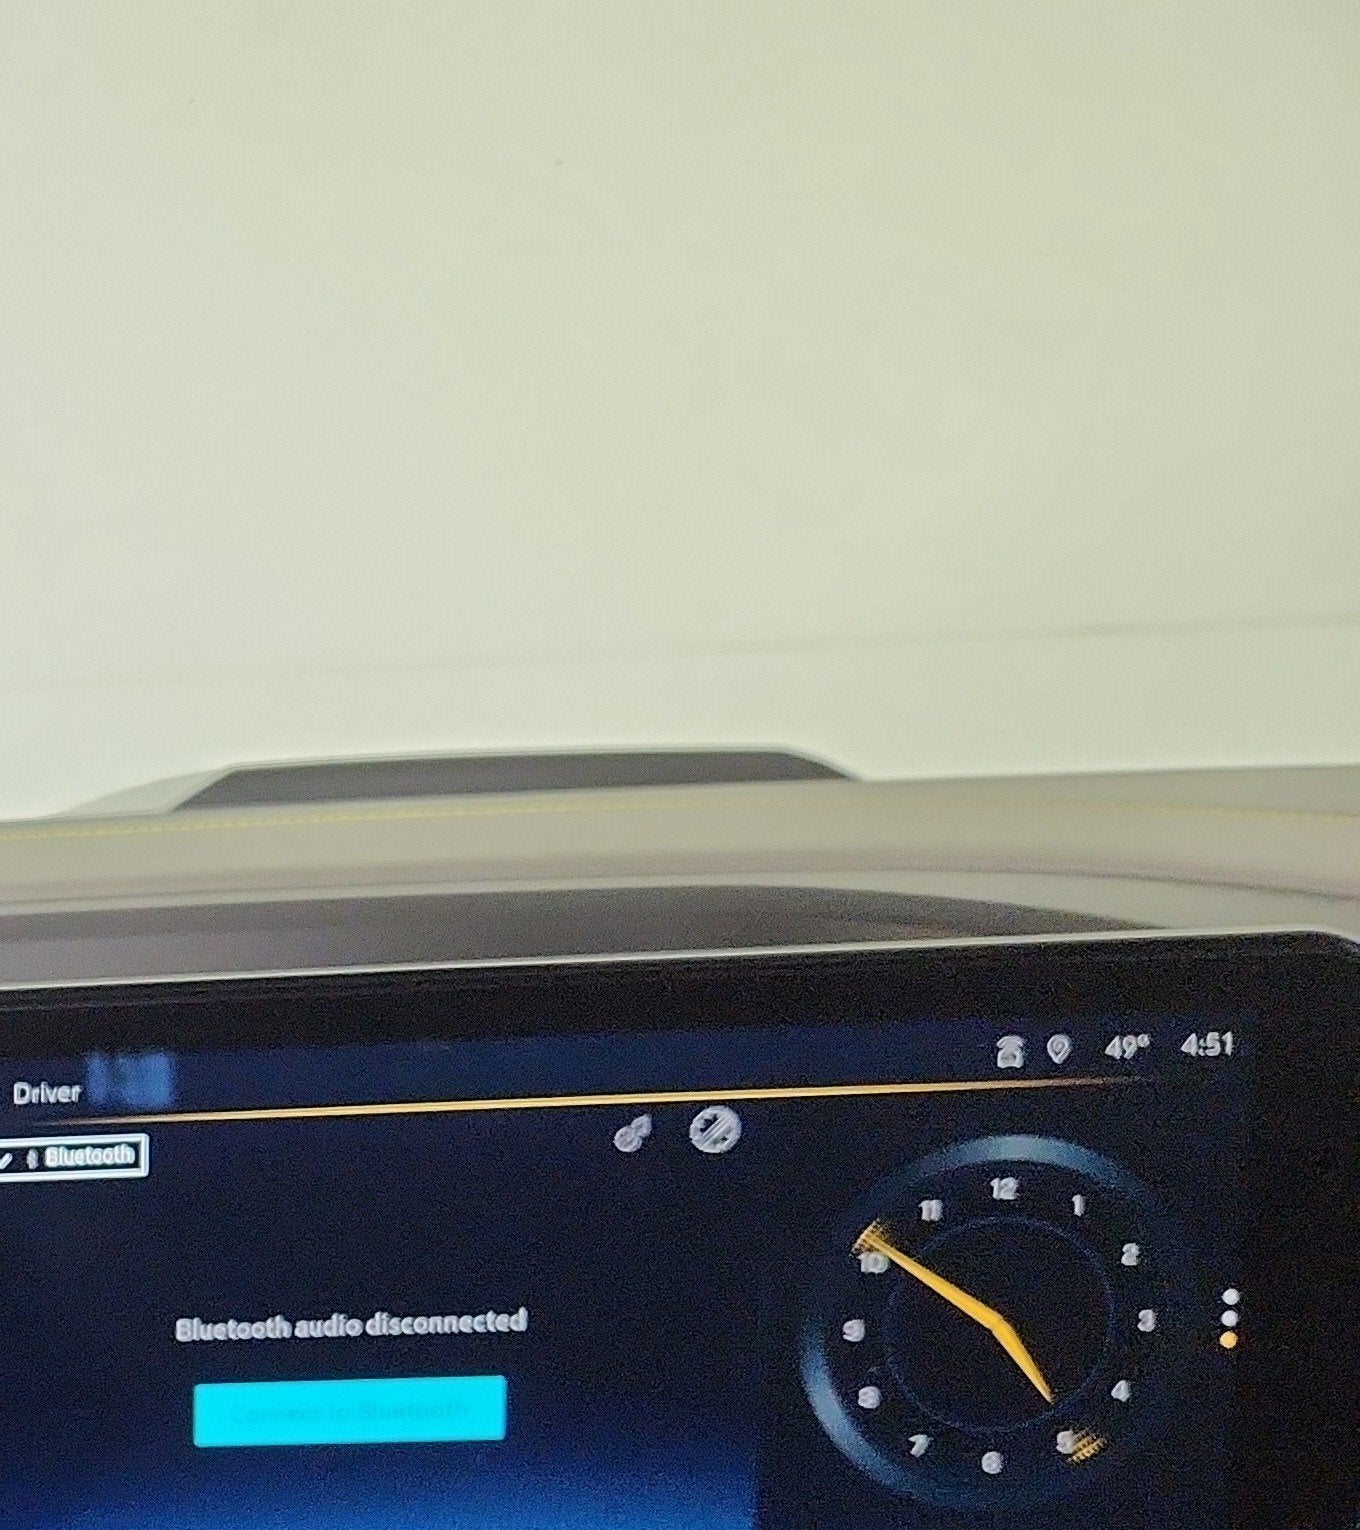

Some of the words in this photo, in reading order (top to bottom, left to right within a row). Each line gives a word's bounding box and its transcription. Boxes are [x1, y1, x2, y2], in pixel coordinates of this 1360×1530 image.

[1181, 1032, 1234, 1057] 4:51
[12, 1079, 81, 1106] Driver
[43, 1144, 136, 1169] Bluetooth
[991, 1177, 1019, 1200] 12
[175, 1316, 292, 1343] Bluetooth
[294, 1312, 364, 1339] audio
[365, 1306, 528, 1337] disconnected
[1111, 1380, 1130, 1402] 4
